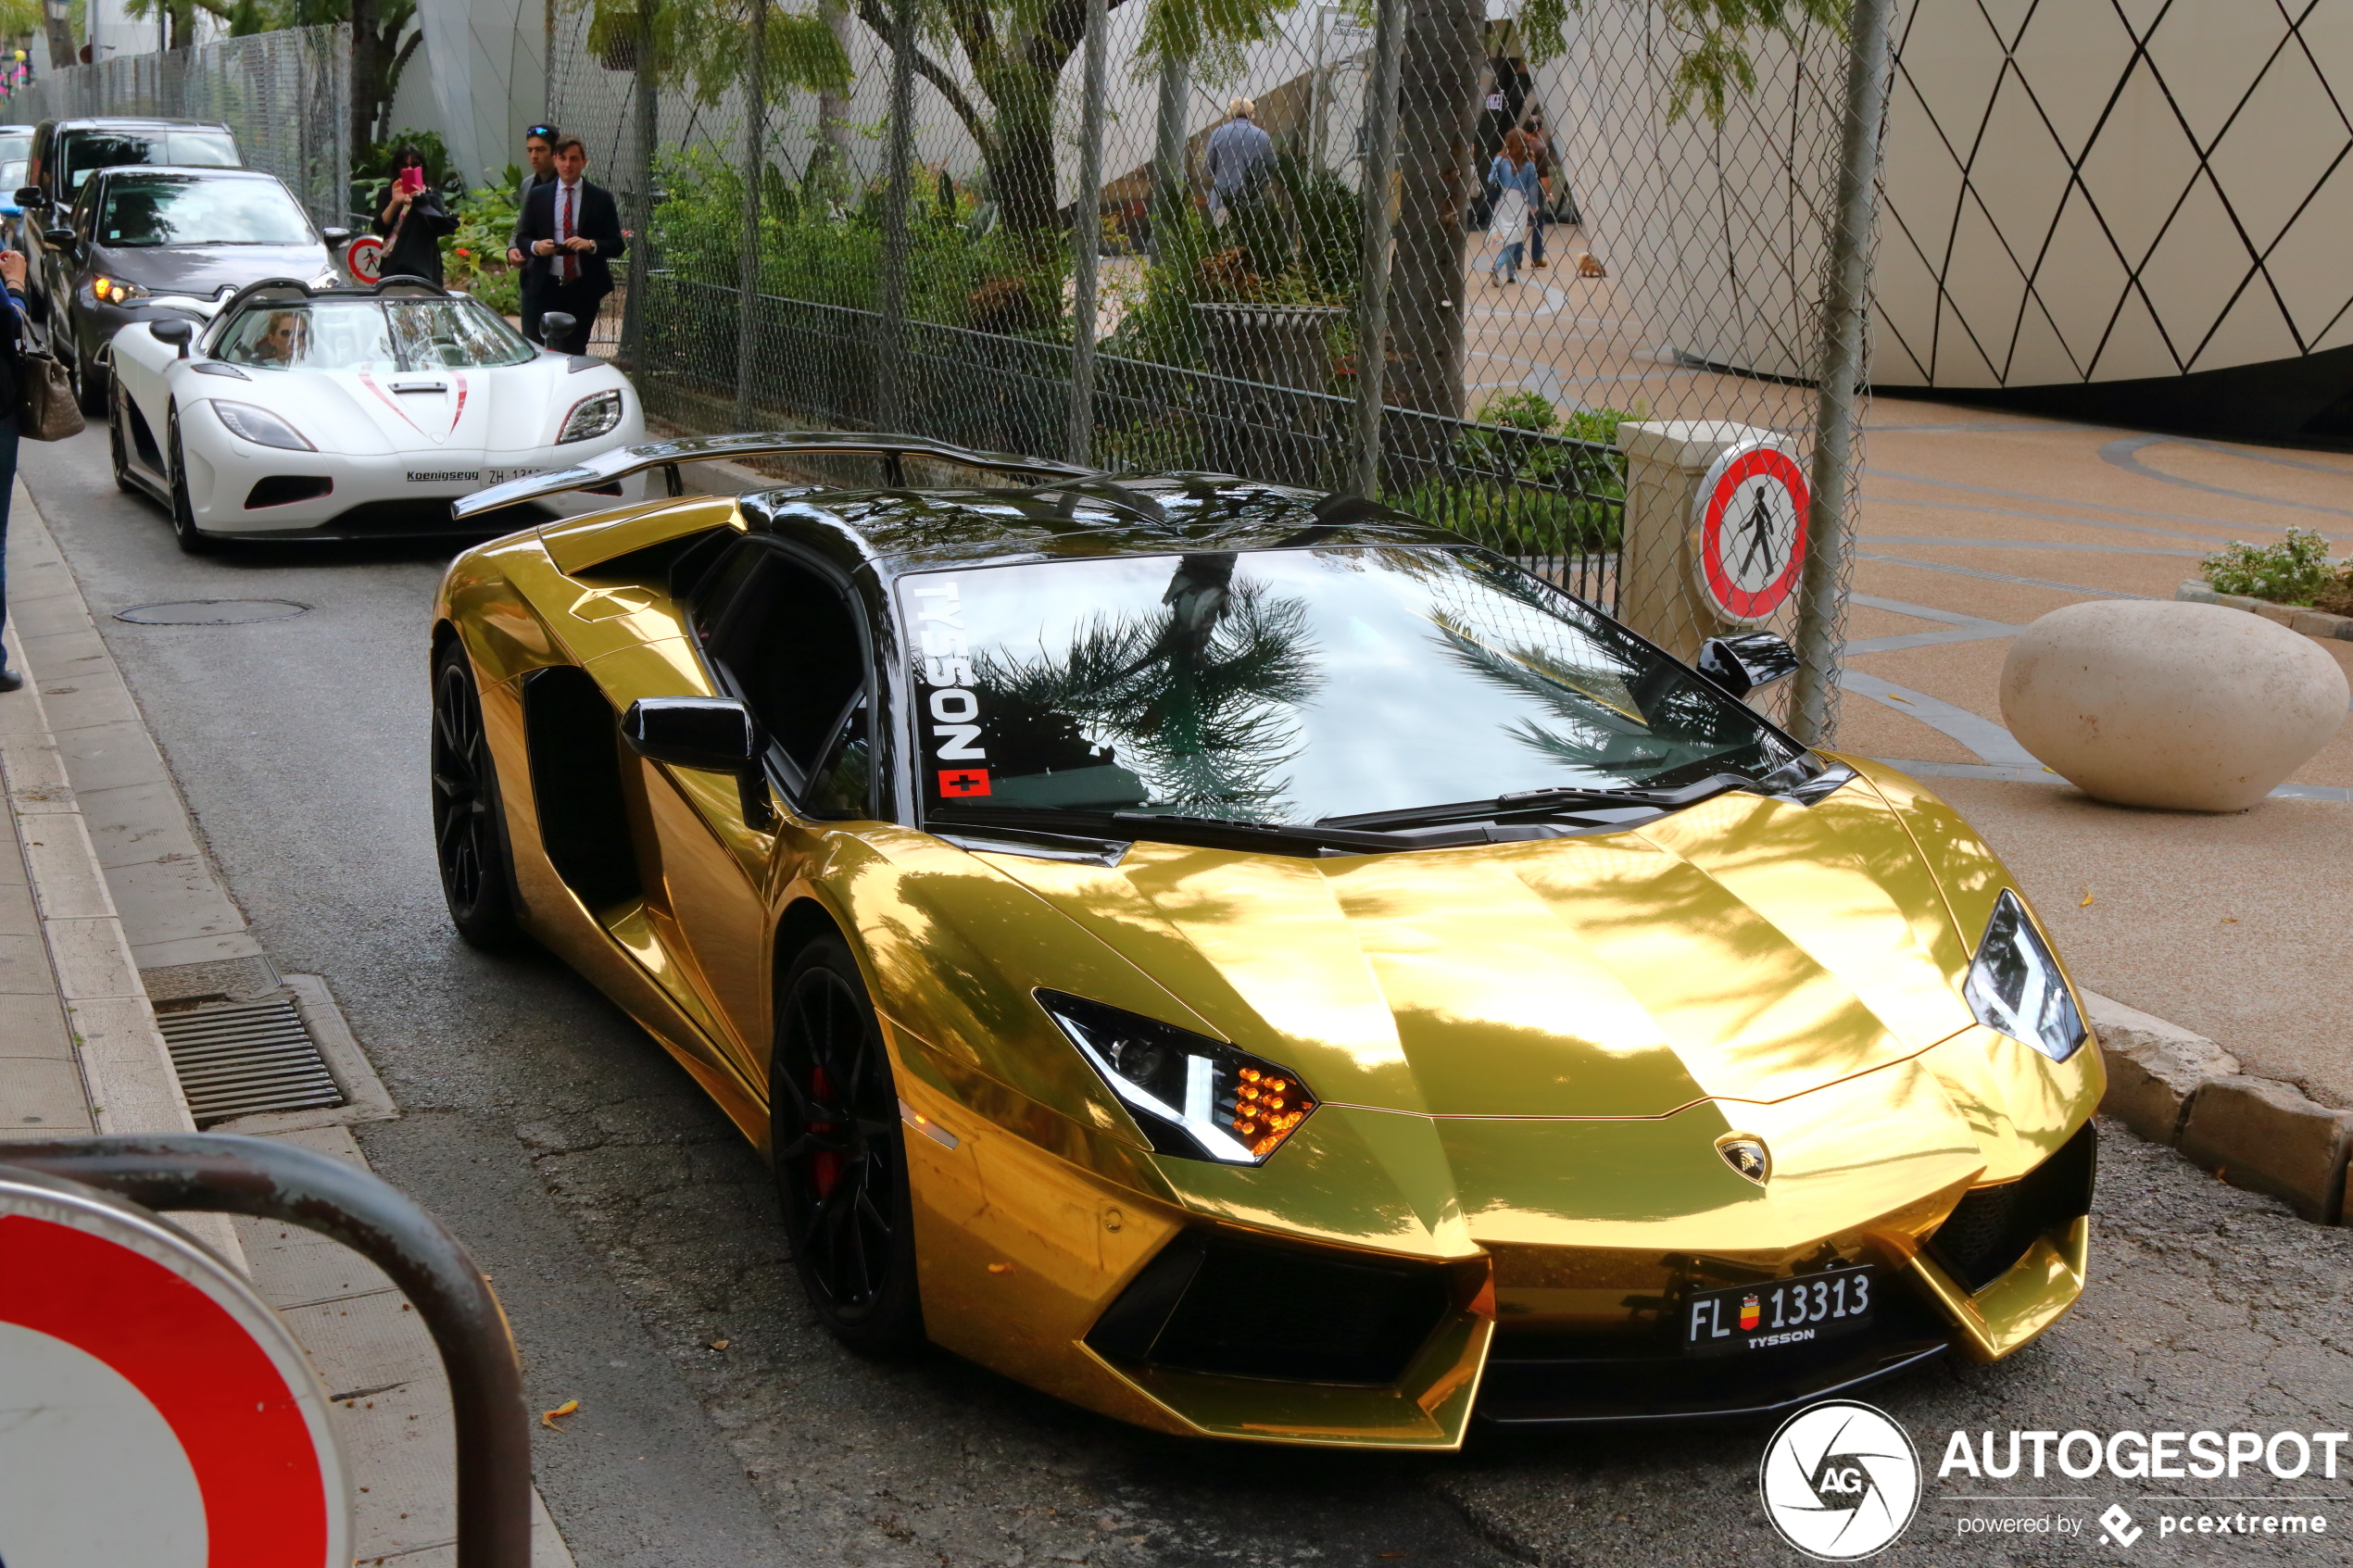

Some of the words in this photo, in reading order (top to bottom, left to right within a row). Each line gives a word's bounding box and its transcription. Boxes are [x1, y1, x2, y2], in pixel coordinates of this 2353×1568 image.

[407, 470, 479, 482] Koenigsegg
[489, 470, 503, 483] ZH
[914, 582, 986, 760] TYSSON
[1691, 1298, 1730, 1342] FL
[1771, 1274, 1869, 1328] 13313
[1749, 1328, 1816, 1349] TYSSON
